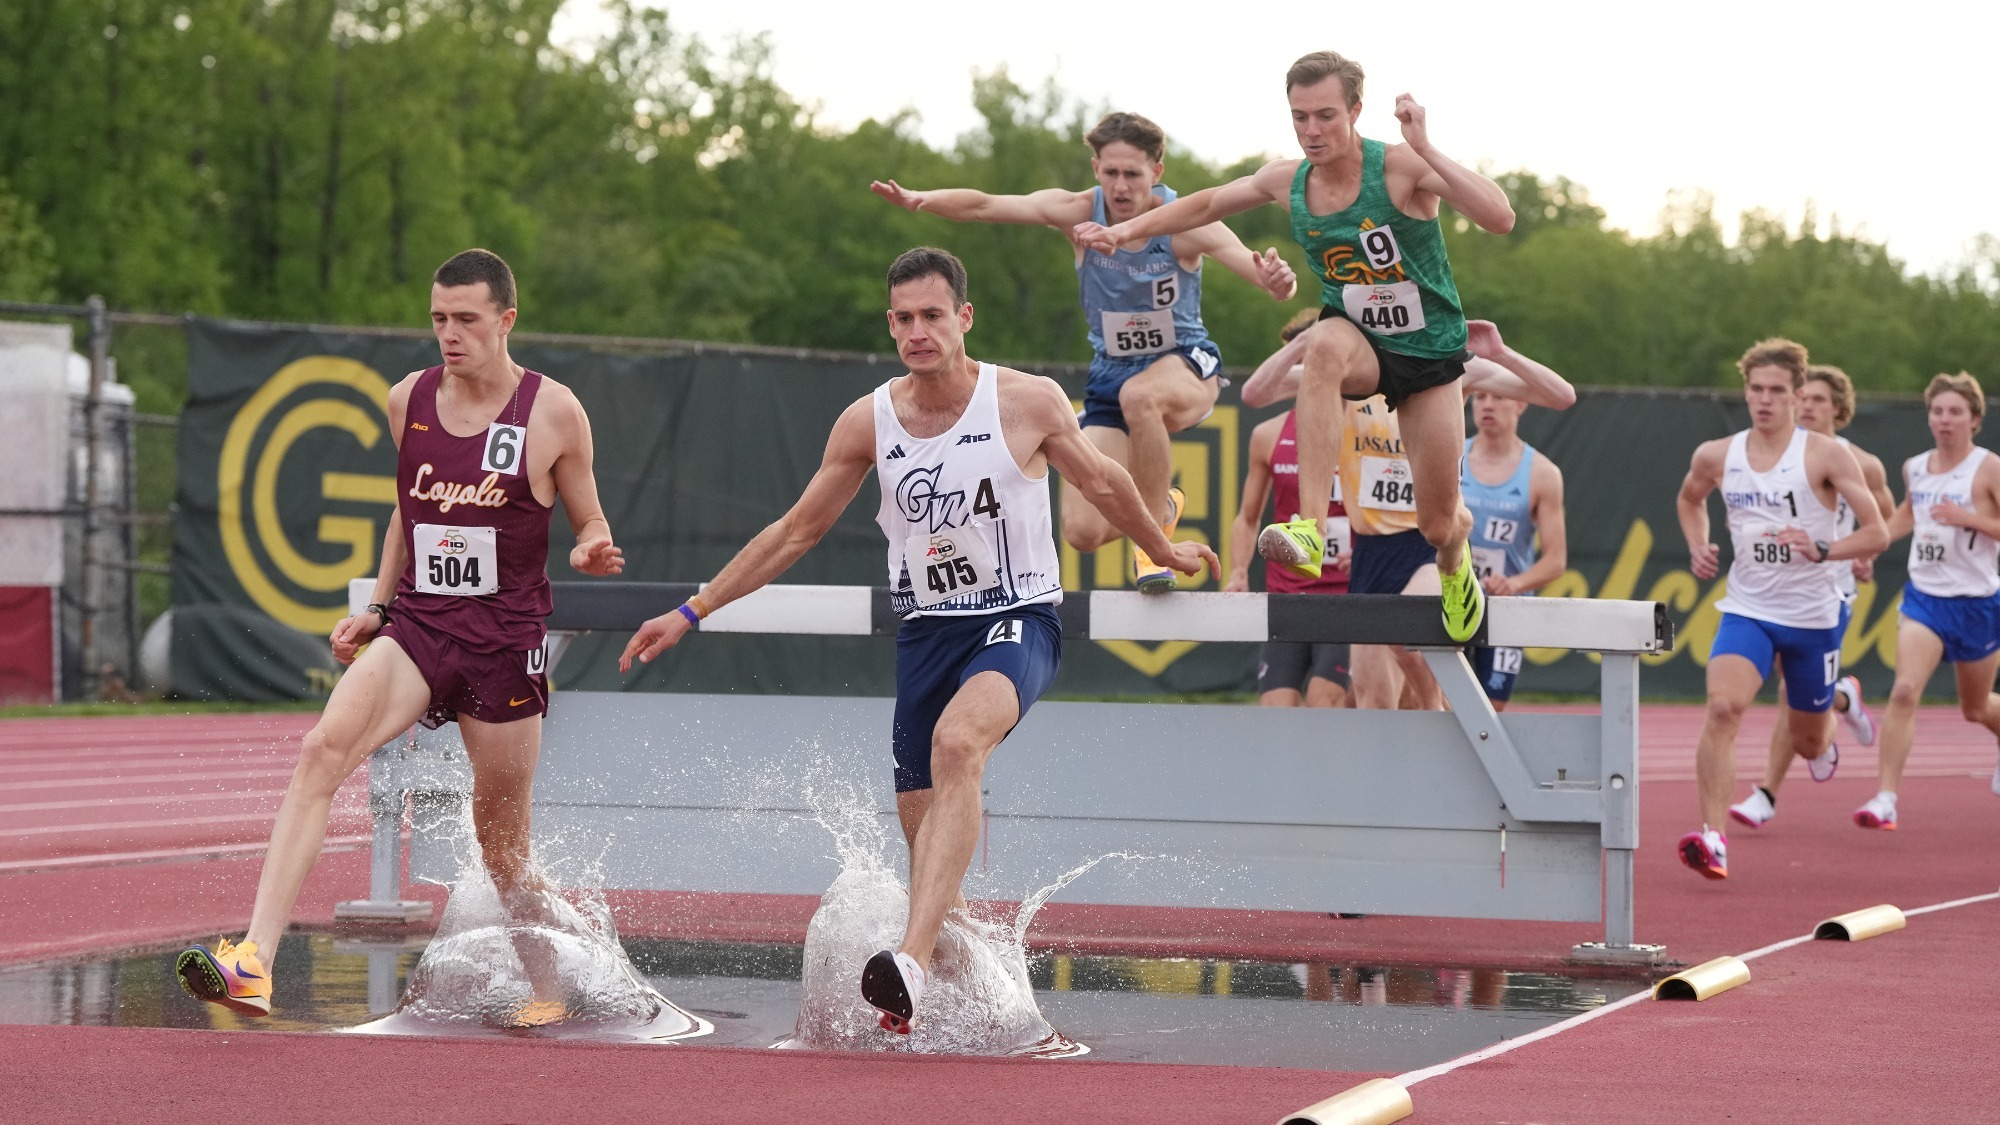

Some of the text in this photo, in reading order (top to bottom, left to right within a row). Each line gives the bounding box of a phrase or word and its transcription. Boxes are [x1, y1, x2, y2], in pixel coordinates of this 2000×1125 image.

[1366, 231, 1395, 266] 9
[1156, 277, 1175, 306] 5
[1361, 305, 1409, 329] 440
[1116, 329, 1163, 351] 535
[487, 427, 518, 470] 6
[955, 432, 992, 446] A10
[409, 463, 509, 513] Loyola
[972, 477, 1001, 520] 4
[1371, 480, 1414, 505] 484
[1726, 491, 1761, 509] SAINT
[1782, 490, 1797, 517] 1
[1490, 520, 1512, 542] 12
[1963, 526, 1978, 550] 7
[437, 539, 464, 549] A10
[926, 544, 953, 557] A10
[1753, 543, 1791, 564] 589
[1916, 543, 1945, 562] 592
[428, 555, 482, 588] 504
[926, 556, 978, 595] 475
[990, 619, 1017, 643] 4
[1498, 648, 1519, 672] 12
[1828, 654, 1835, 679] 1
